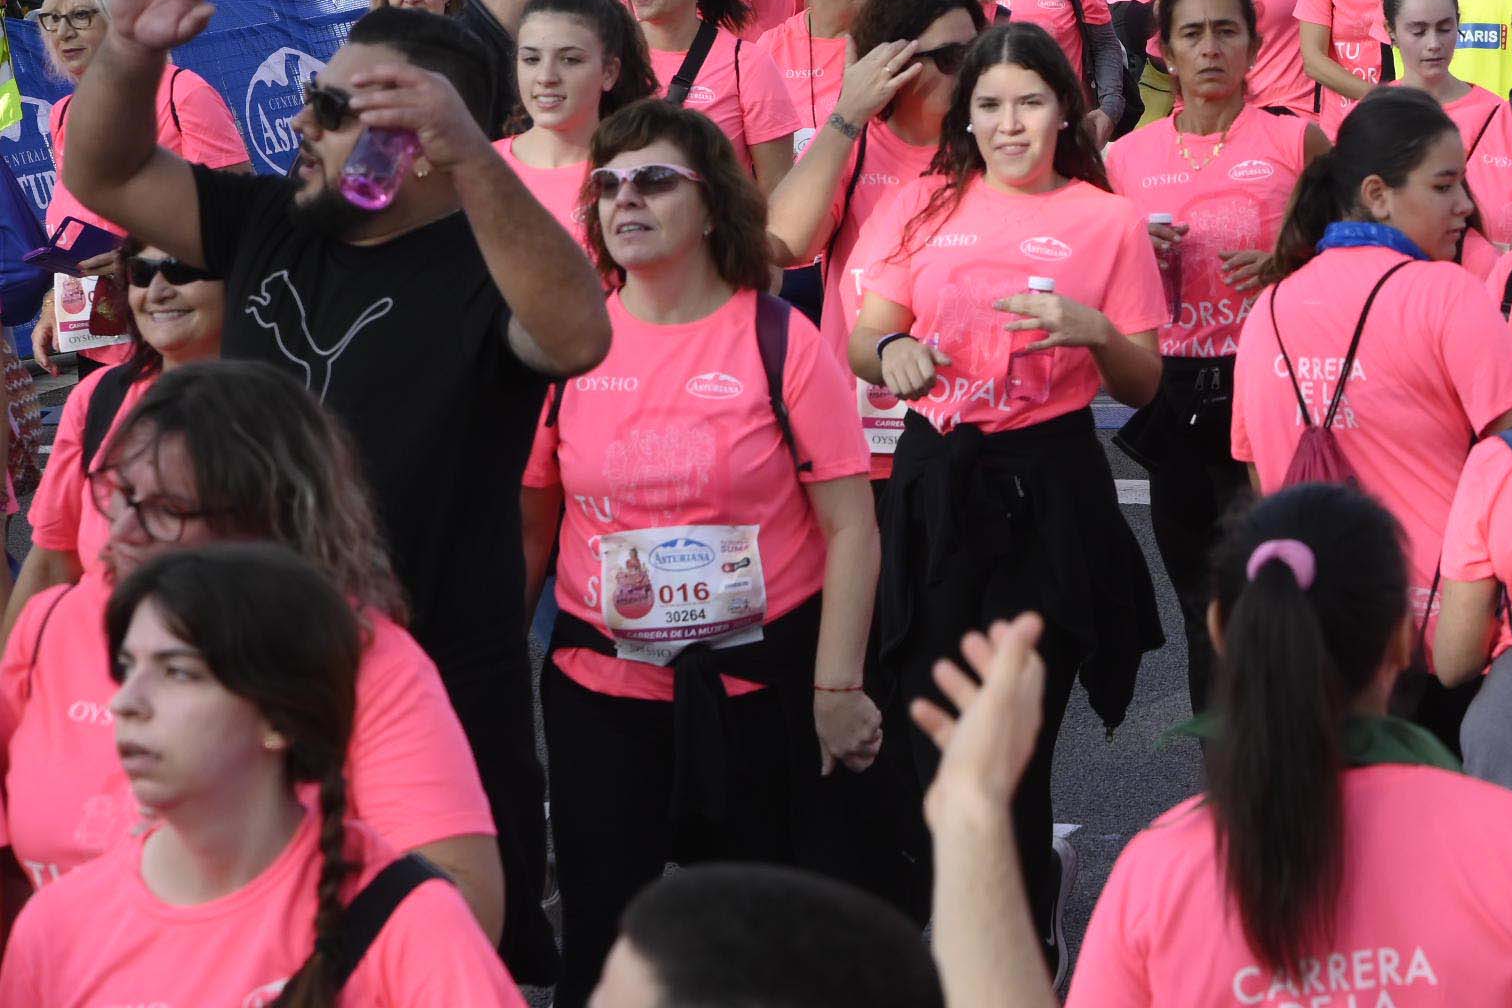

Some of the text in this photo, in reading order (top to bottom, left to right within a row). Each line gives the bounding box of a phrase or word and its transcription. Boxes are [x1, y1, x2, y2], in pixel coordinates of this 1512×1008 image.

[1335, 41, 1361, 60] TU
[1142, 173, 1190, 189] OYSHO
[575, 376, 639, 392] OYSHO
[655, 552, 711, 565] ASTURIANA
[659, 581, 711, 605] 016
[665, 608, 707, 624] 30264
[671, 628, 682, 638] DE
[685, 628, 697, 637] LA
[1232, 945, 1438, 1005] CARRERA
